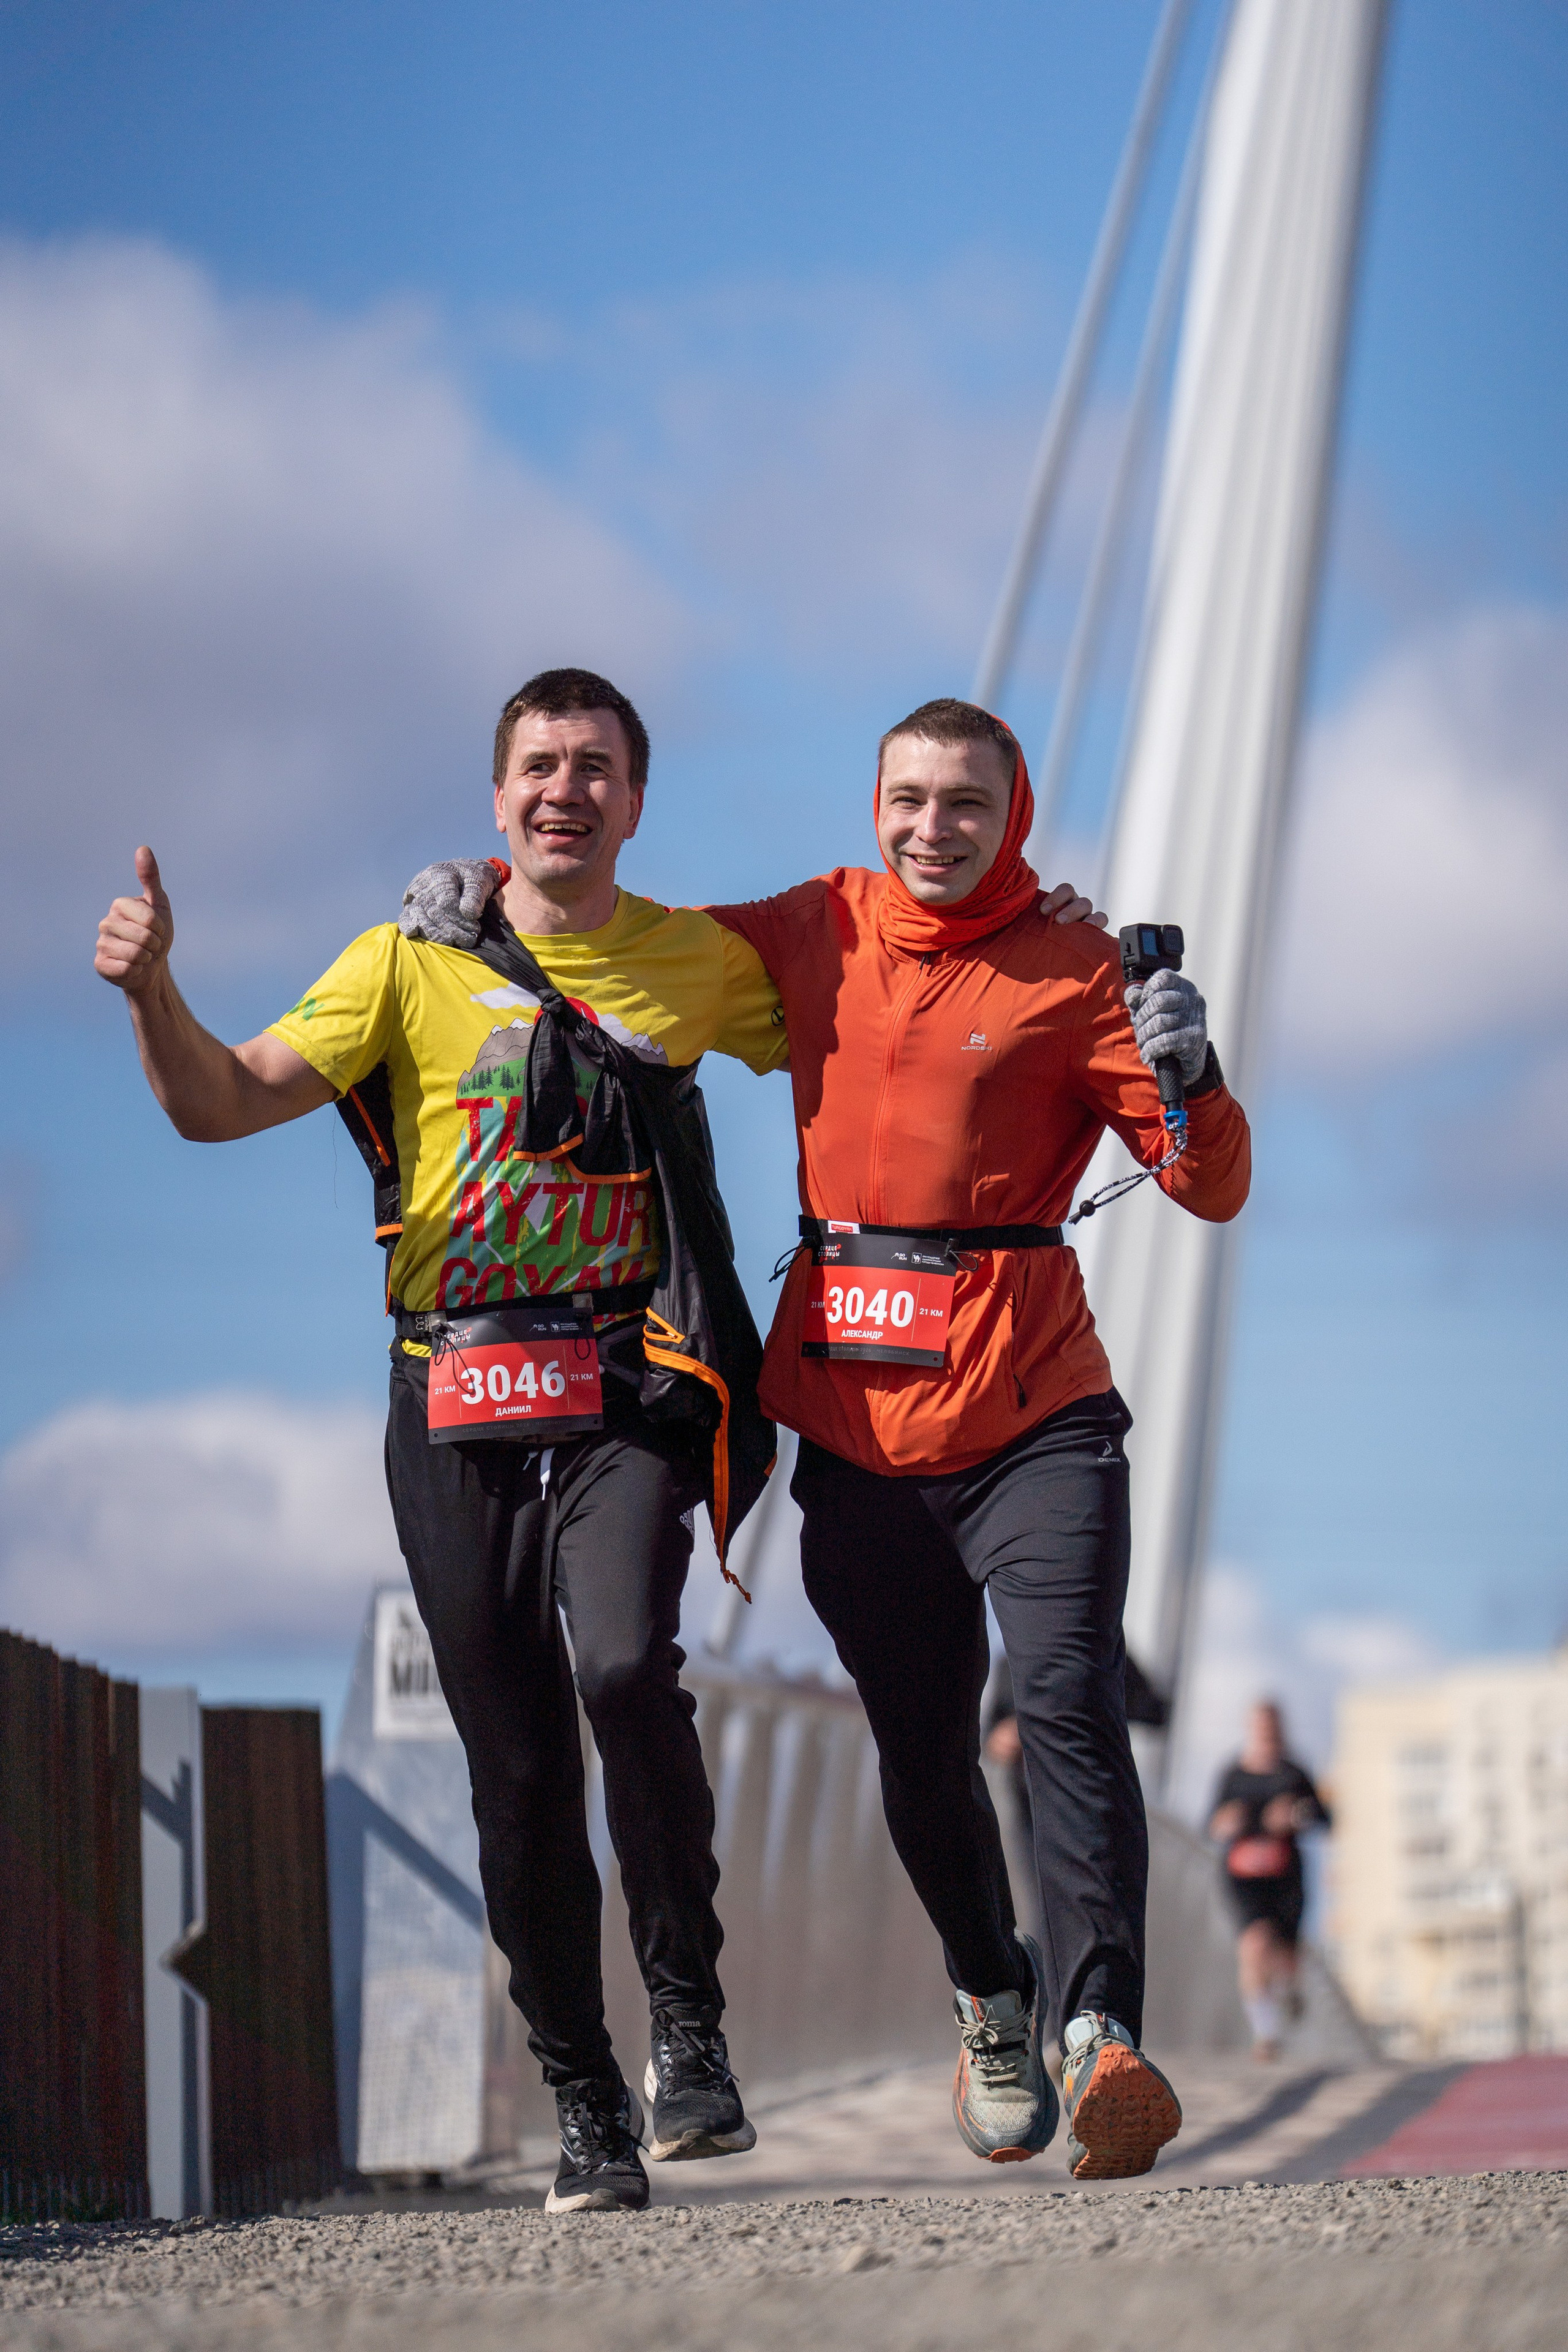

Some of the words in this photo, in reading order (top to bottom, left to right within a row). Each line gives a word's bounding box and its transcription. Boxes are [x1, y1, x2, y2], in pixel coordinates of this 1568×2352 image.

[827, 1286, 914, 1328] 3040
[440, 1334, 471, 1346] СОЛИЦЫ
[841, 1329, 883, 1340] АЛЕКСАНДР
[460, 1360, 566, 1405] 3046
[434, 1387, 443, 1395] 21
[495, 1404, 532, 1417] ДАНИИЛ
